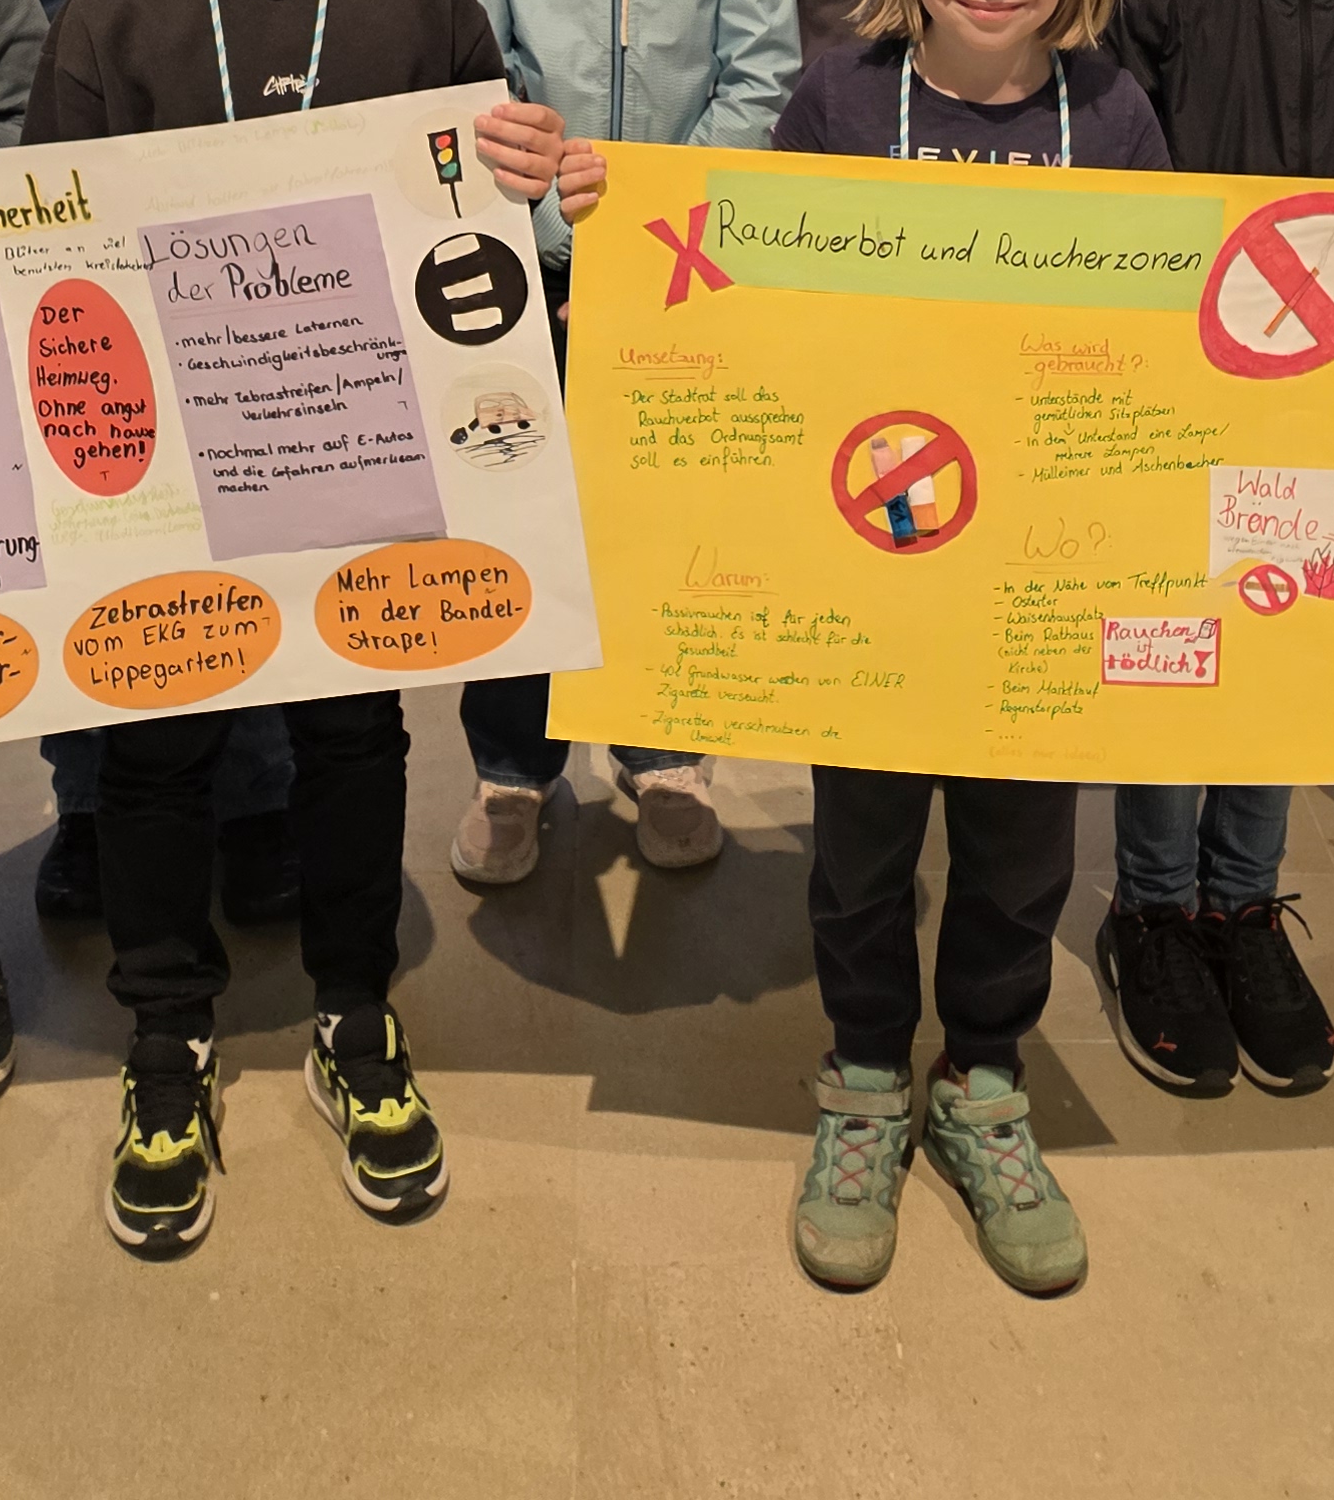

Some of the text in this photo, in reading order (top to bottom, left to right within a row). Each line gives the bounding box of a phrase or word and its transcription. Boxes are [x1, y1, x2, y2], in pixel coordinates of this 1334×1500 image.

[717, 199, 1202, 272] Rauchverbot und Raucherzonen
[144, 223, 318, 279] Lösungen
[168, 262, 353, 303] der Probleme
[40, 306, 85, 325] Der
[296, 317, 364, 334] Laternen
[39, 335, 113, 358] Sichere
[1020, 333, 1110, 356] Was wird
[619, 343, 723, 380] Umsetzung:
[36, 363, 118, 395] Heimweg.
[630, 385, 779, 404] Der Stadtrat soll das
[1112, 389, 1133, 406] mit
[38, 399, 147, 423] Ohne angst
[638, 405, 804, 434] Rauchverbot aussprechen
[1034, 406, 1102, 434] gemütlichen
[44, 420, 96, 439] nach
[630, 427, 805, 455] und das Ordnungsamt
[1078, 426, 1139, 444] Unterstand
[1149, 427, 1172, 439] eine
[73, 440, 146, 469] gehen!
[278, 441, 315, 455] mehr
[322, 434, 349, 452] auf
[357, 431, 414, 446] E-Autos
[1103, 444, 1155, 461] Lampen
[243, 463, 266, 478] die
[630, 451, 660, 470] soll
[673, 456, 688, 467] es
[1032, 465, 1091, 484] Mülleimer
[1101, 462, 1122, 476] und
[217, 484, 270, 493] machen
[1237, 469, 1297, 500] Wald
[1217, 495, 1319, 541] Brände
[685, 545, 770, 589] Warum:
[336, 567, 391, 593] Mehr
[1024, 579, 1043, 593] der
[1053, 578, 1087, 593] Nähe
[1096, 581, 1122, 590] vom
[1127, 571, 1209, 598] Treffpunkt
[89, 583, 263, 631] Zebrastreifen
[339, 598, 523, 623] in der Bandel-
[1012, 595, 1059, 608] Ostertor
[781, 609, 806, 627] für
[810, 607, 851, 638] jeden
[1006, 605, 1104, 628] Waisenhausplatz
[74, 619, 258, 656] vom EKG zum
[731, 625, 745, 640] Es
[754, 630, 767, 641] ist
[826, 631, 847, 648] für
[851, 632, 872, 645] die
[1005, 627, 1095, 642] Beim Rathaus
[1034, 645, 1067, 656] neben
[1073, 644, 1093, 655] der
[90, 647, 246, 690] Lippegarten!
[688, 664, 762, 687] Grundwasser
[818, 677, 841, 687] von
[851, 670, 905, 689] EINER
[656, 683, 709, 710] Zigarette
[1002, 682, 1031, 695] Beim
[652, 710, 843, 740] Zigaretten verschmutzen die
